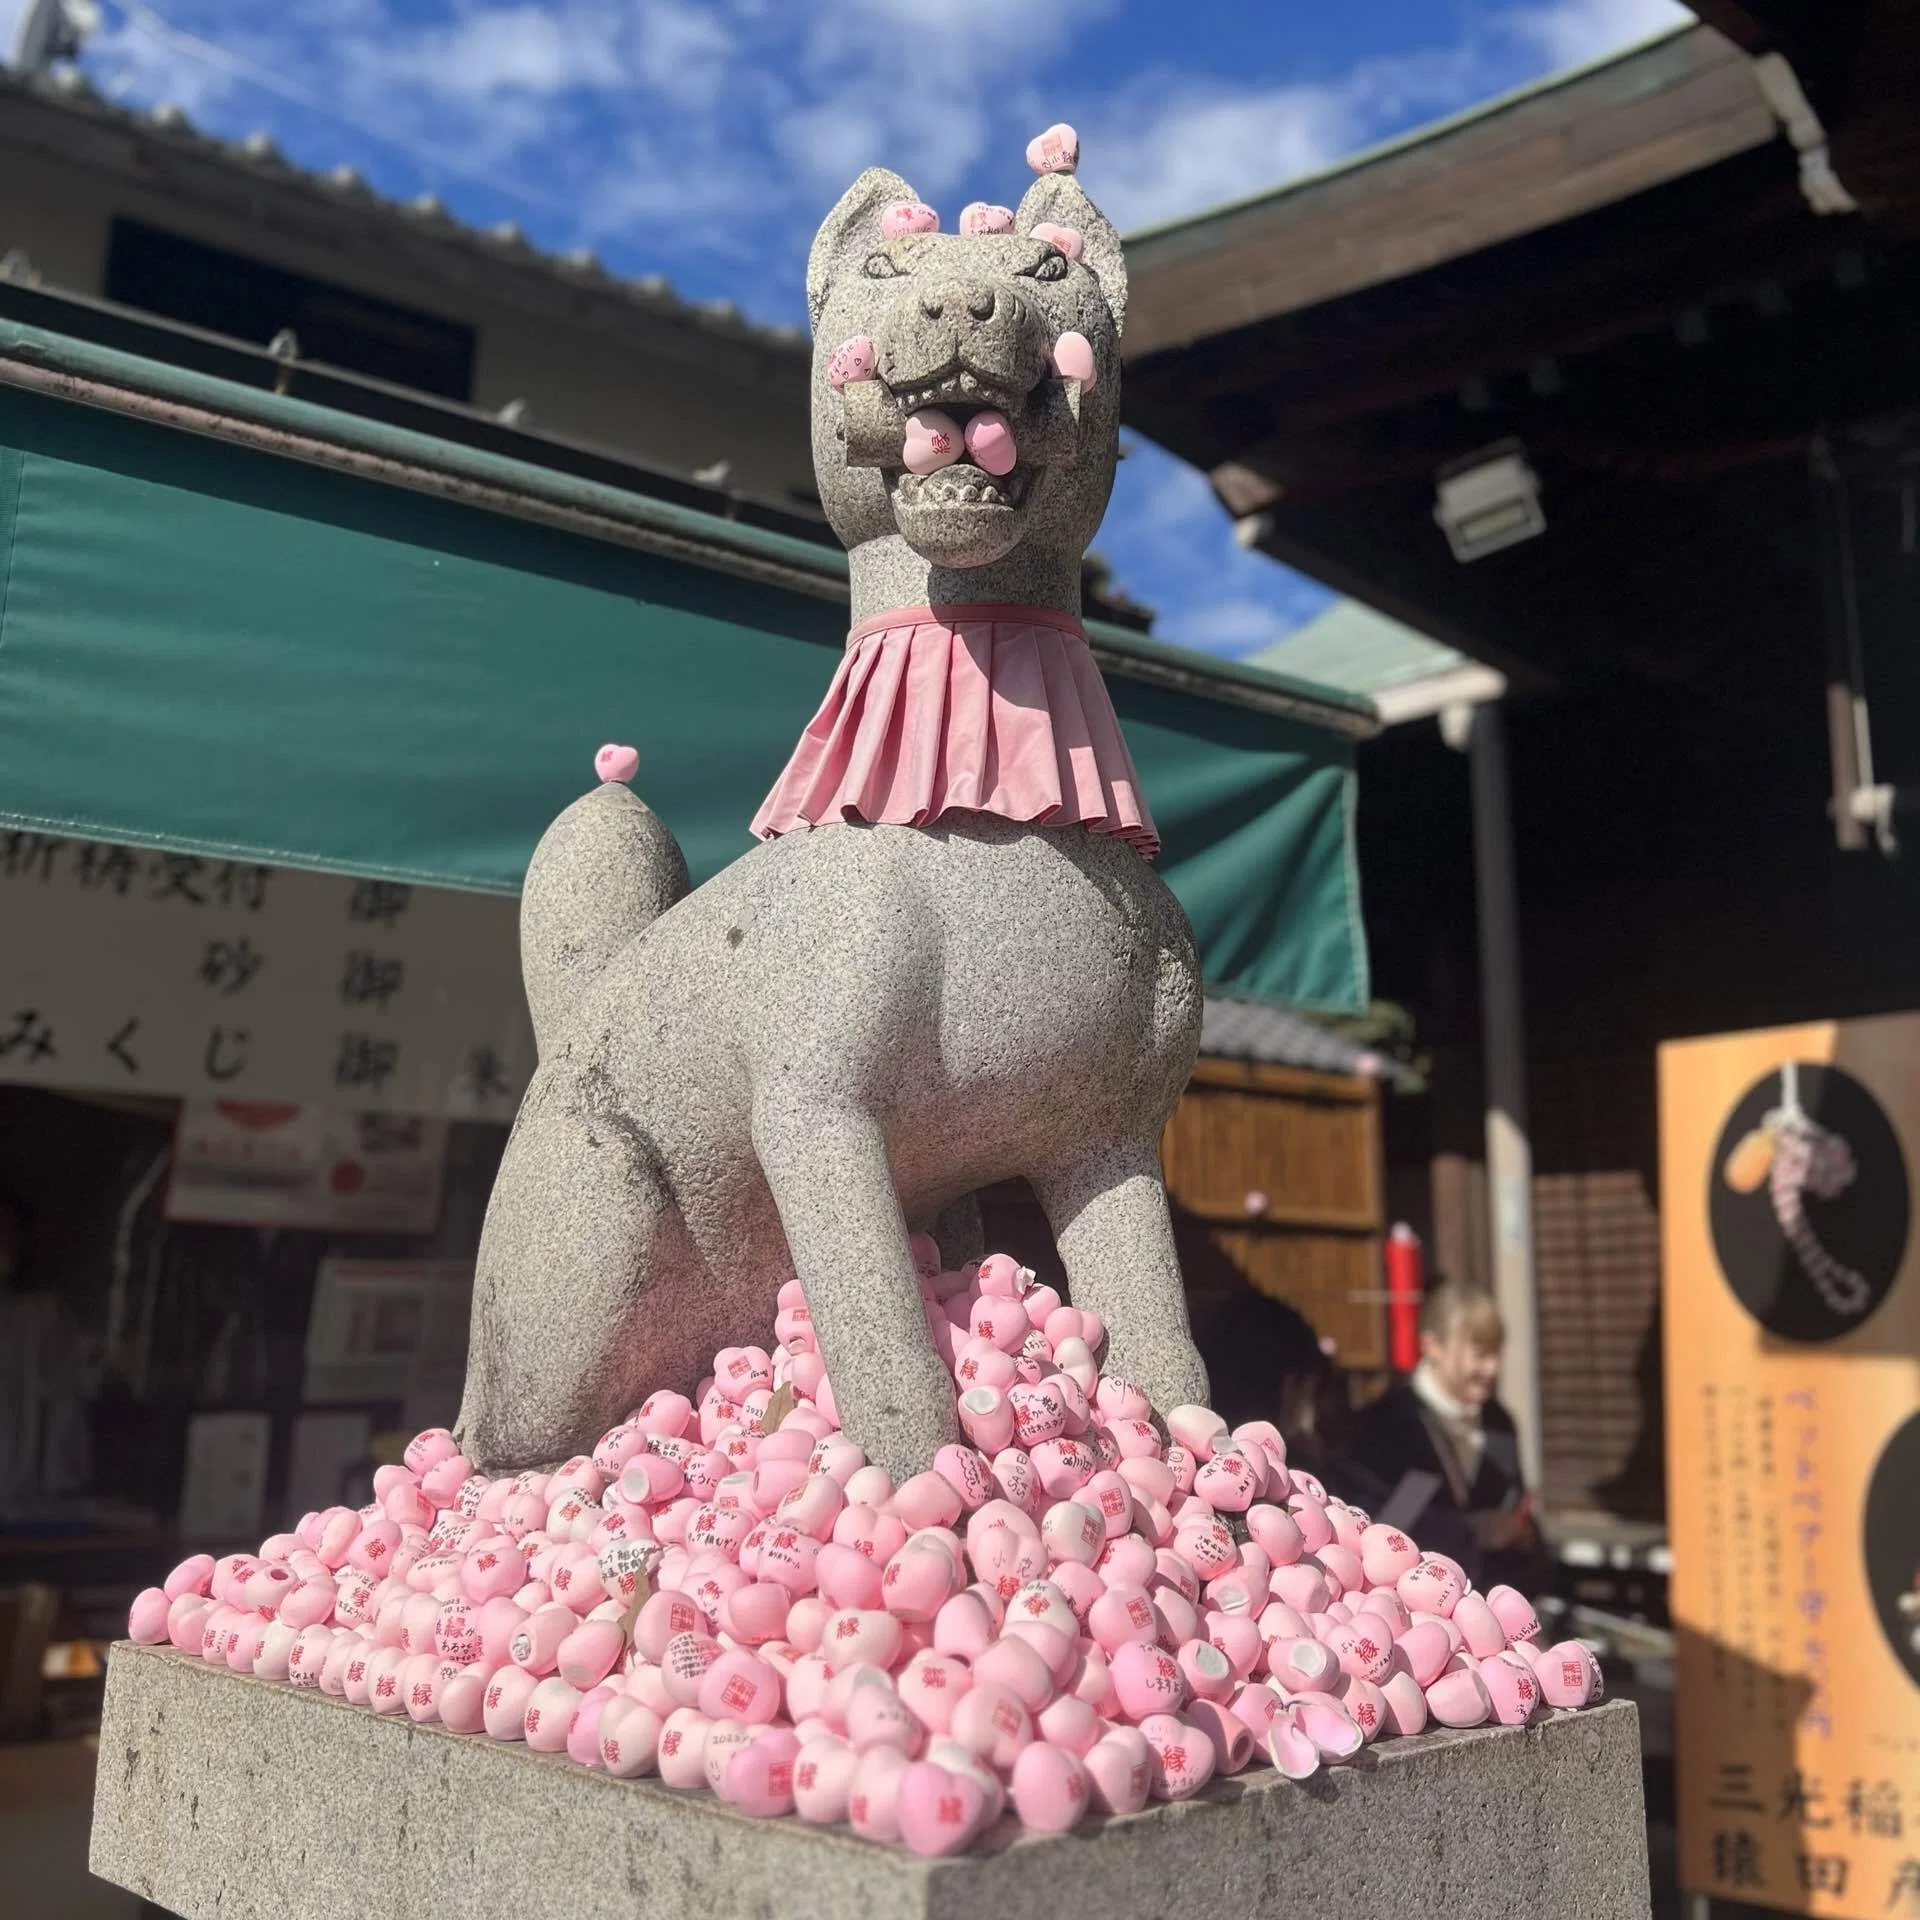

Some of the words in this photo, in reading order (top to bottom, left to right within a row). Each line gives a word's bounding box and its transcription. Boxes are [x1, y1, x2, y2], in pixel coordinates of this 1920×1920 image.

[931, 433, 950, 453] 縁
[977, 1320, 995, 1340] 縁
[960, 1357, 978, 1381] 縁
[717, 1404, 735, 1419] 縁
[728, 1441, 748, 1457] 縁
[1223, 1458, 1243, 1476] 縁
[696, 1514, 717, 1533] 縁
[774, 1532, 797, 1550] 縁
[554, 1567, 571, 1592] 縁
[618, 1571, 637, 1596] 縁
[1426, 1565, 1448, 1581] 縁
[352, 1587, 370, 1608] 縁
[997, 1576, 1020, 1599] 縁
[444, 1616, 466, 1638] 縁
[836, 1617, 859, 1640] 縁
[1355, 1637, 1380, 1664] 縁
[347, 1661, 365, 1682] 縁
[1157, 1655, 1177, 1680] 縁
[376, 1674, 397, 1697] 縁
[411, 1682, 433, 1706] 縁
[1517, 1678, 1533, 1700] 縁
[1357, 1703, 1377, 1727] 縁
[1162, 1745, 1186, 1773] 縁
